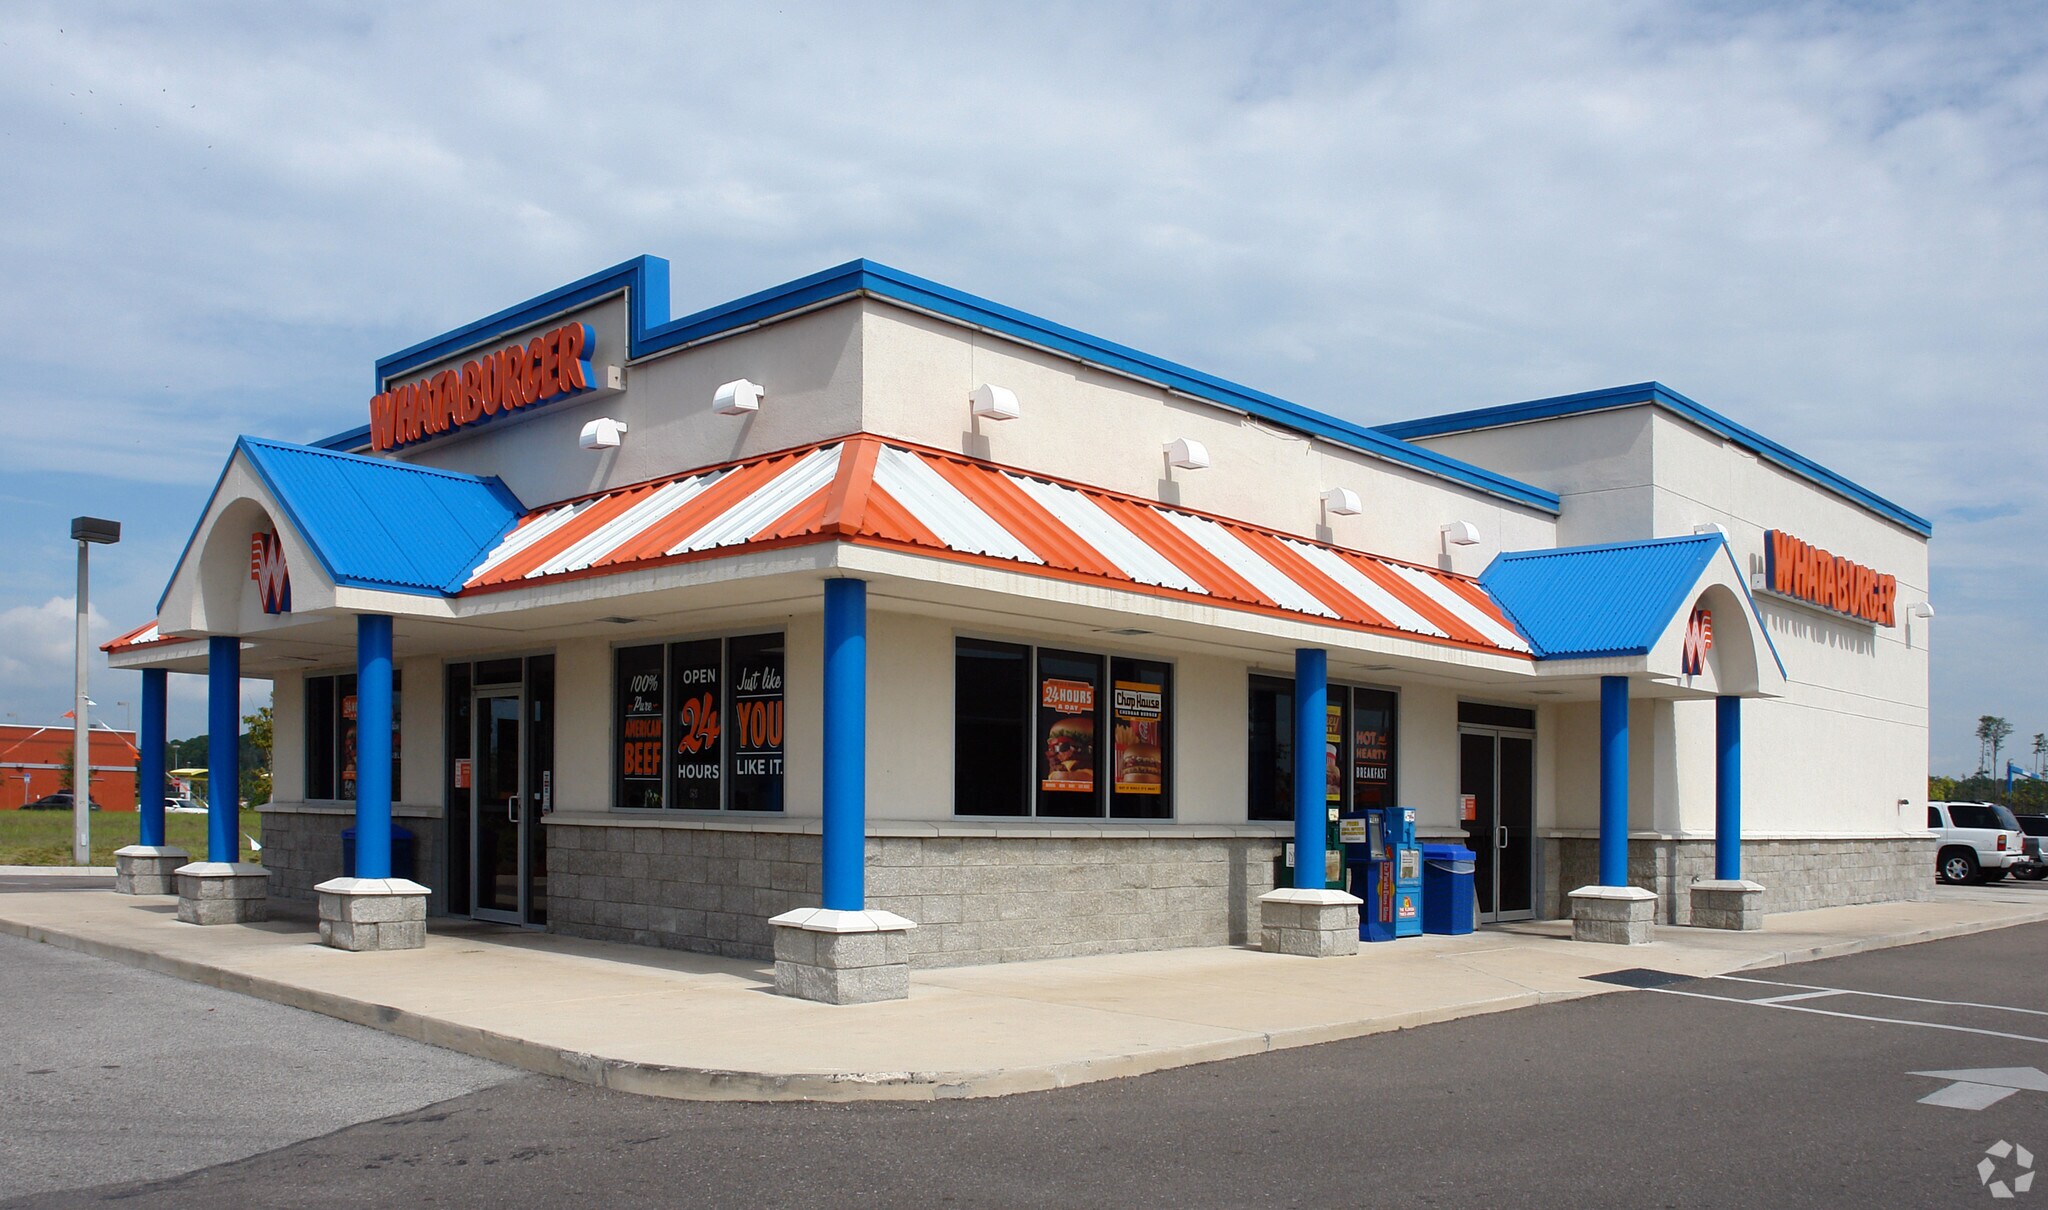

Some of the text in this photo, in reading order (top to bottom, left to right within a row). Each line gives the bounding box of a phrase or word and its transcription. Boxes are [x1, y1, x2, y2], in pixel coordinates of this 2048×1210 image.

[370, 322, 586, 451] WHATABURGER
[1768, 529, 1896, 628] WHATABURGER
[630, 674, 658, 693] 100%
[683, 668, 716, 684] OPEN
[736, 666, 782, 691] Just like
[633, 696, 653, 712] Pure
[1044, 686, 1092, 704] 24 HOURS
[1117, 691, 1160, 711] Chop House
[625, 719, 662, 738] AMERICAN
[678, 692, 721, 754] 24
[736, 700, 783, 748] YOU
[1356, 731, 1377, 746] HOT
[624, 741, 661, 776] BEEF
[1356, 747, 1387, 760] HEARTY
[678, 764, 719, 779] HOURS
[736, 759, 784, 775] LIKE IT.
[1356, 766, 1387, 779] BREAKFAST
